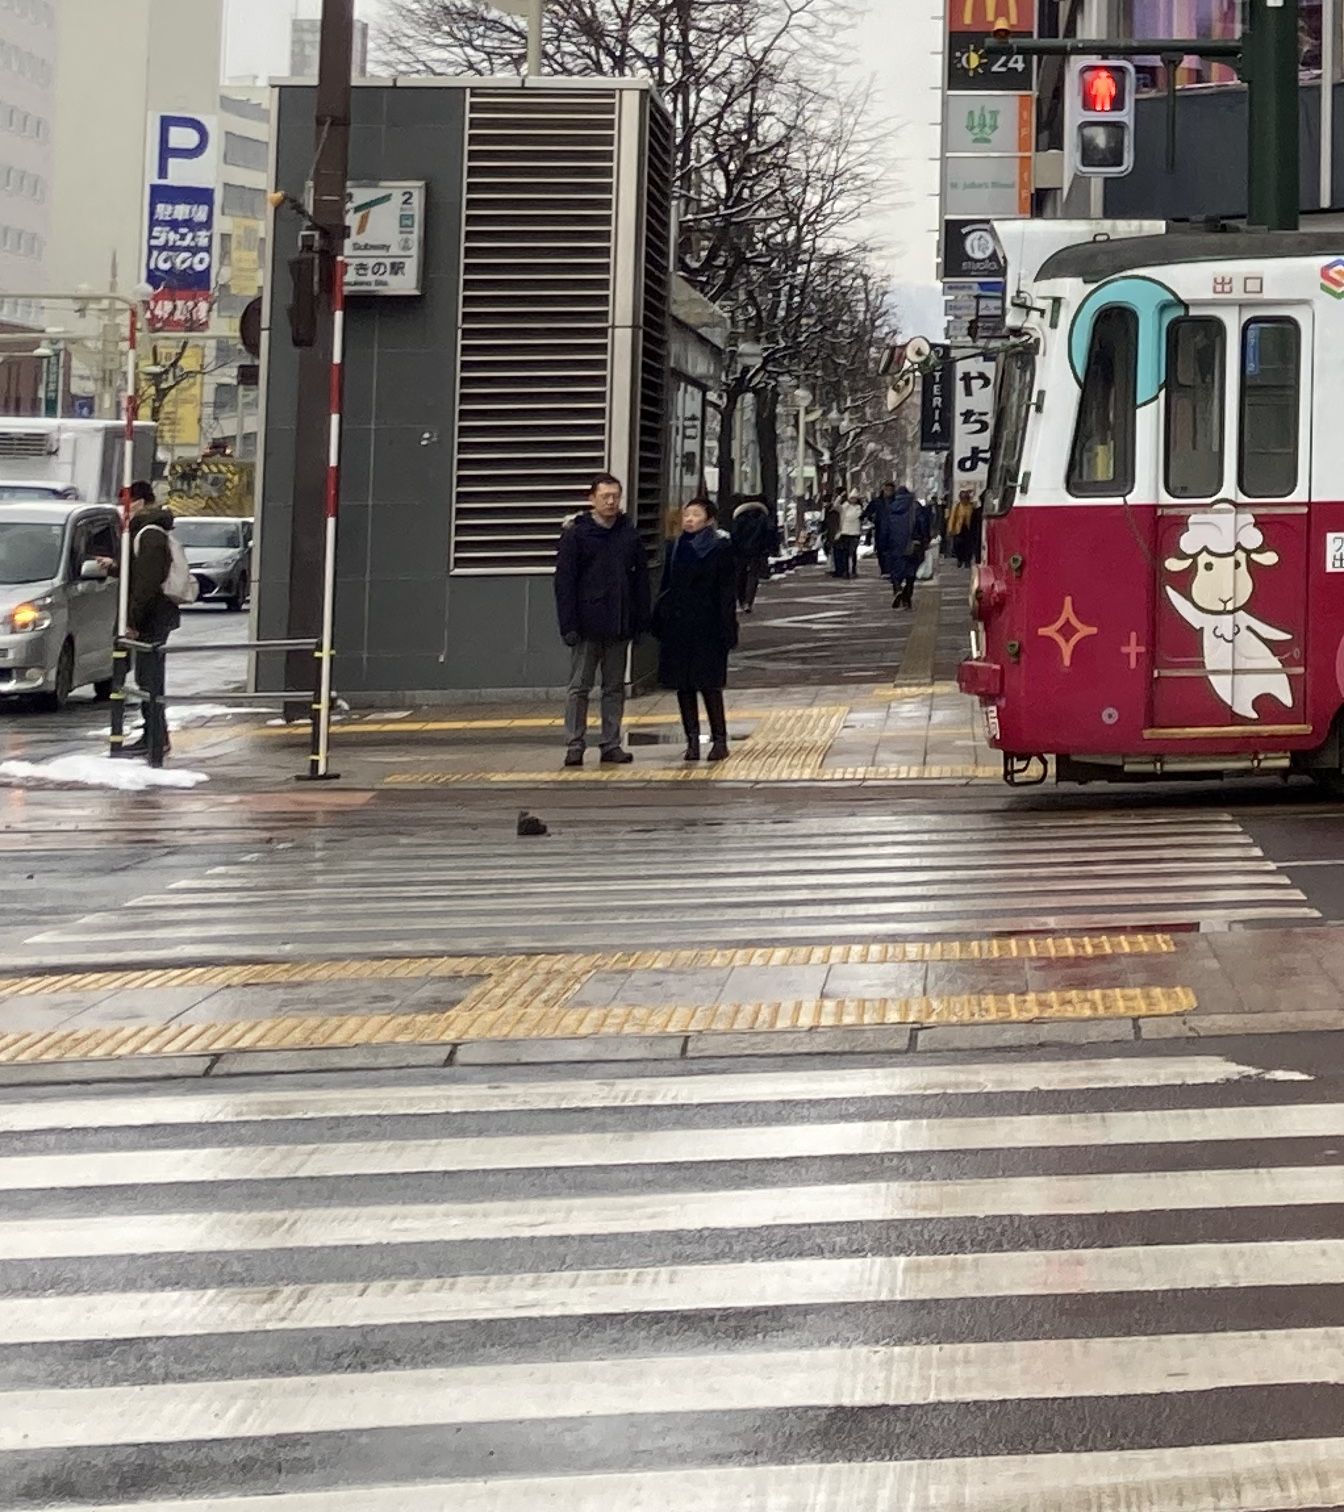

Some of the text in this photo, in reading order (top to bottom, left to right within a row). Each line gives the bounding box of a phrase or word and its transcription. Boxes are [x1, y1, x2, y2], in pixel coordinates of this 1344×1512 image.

[157, 114, 210, 180] P
[401, 190, 414, 206] 2
[153, 202, 209, 223] 駐車場
[345, 261, 406, 277] きの駅
[1212, 275, 1264, 294] 出口
[957, 370, 992, 473] やちよ
